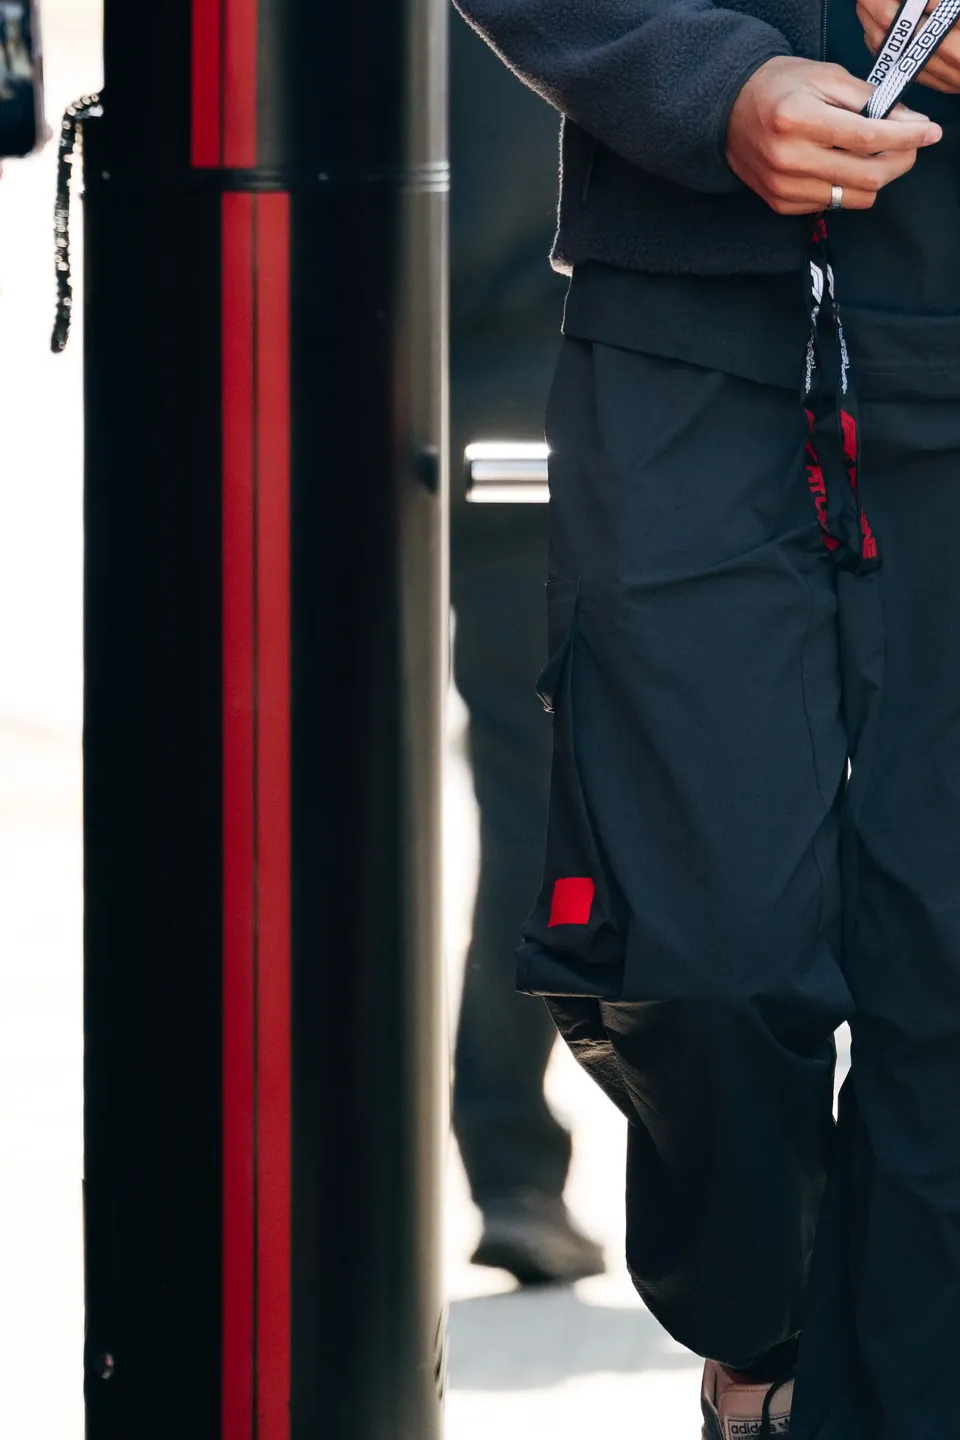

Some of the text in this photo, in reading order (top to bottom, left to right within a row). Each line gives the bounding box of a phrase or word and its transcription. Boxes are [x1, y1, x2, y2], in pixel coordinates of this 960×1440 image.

[870, 19, 913, 87] GRID ACCE
[899, 18, 948, 77] 2026
[809, 260, 824, 305] F1
[730, 1422, 777, 1435] adids
